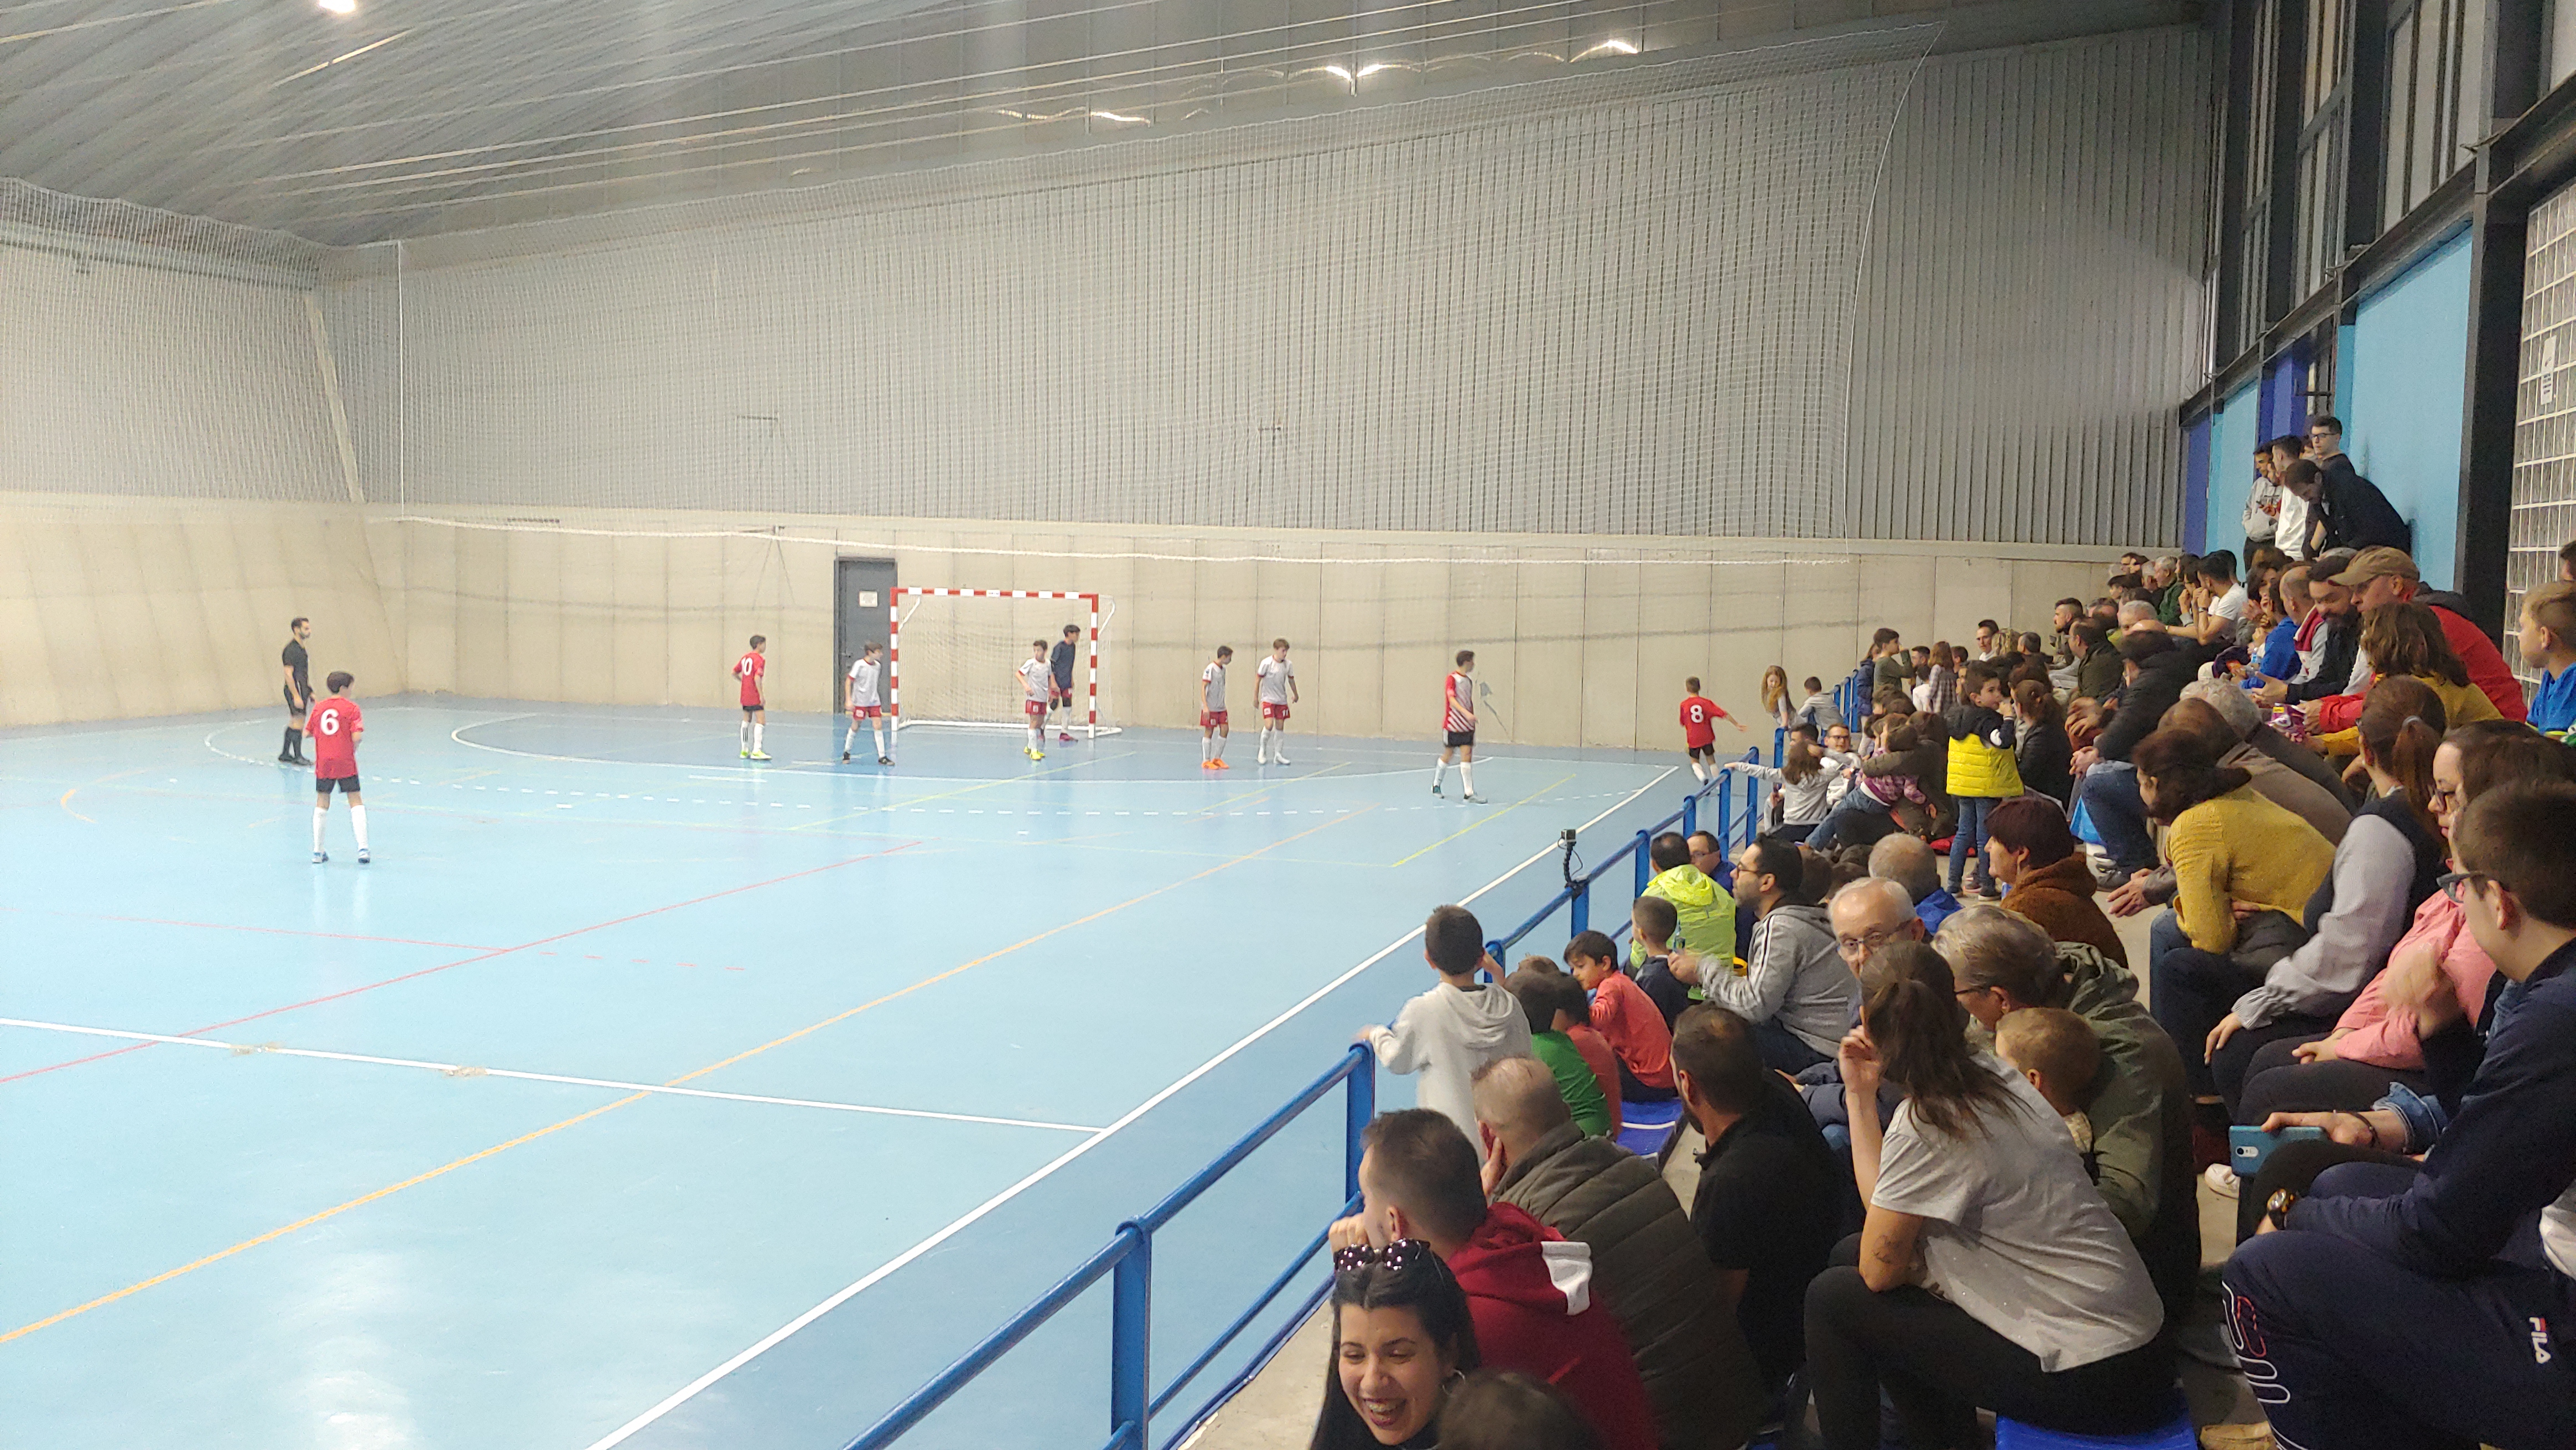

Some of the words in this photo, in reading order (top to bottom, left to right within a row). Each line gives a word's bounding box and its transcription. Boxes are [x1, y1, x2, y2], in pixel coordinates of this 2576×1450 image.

[741, 657, 753, 676] 10
[321, 708, 340, 736] 6
[1690, 705, 1704, 723] 8
[2529, 1317, 2551, 1364] FILA
